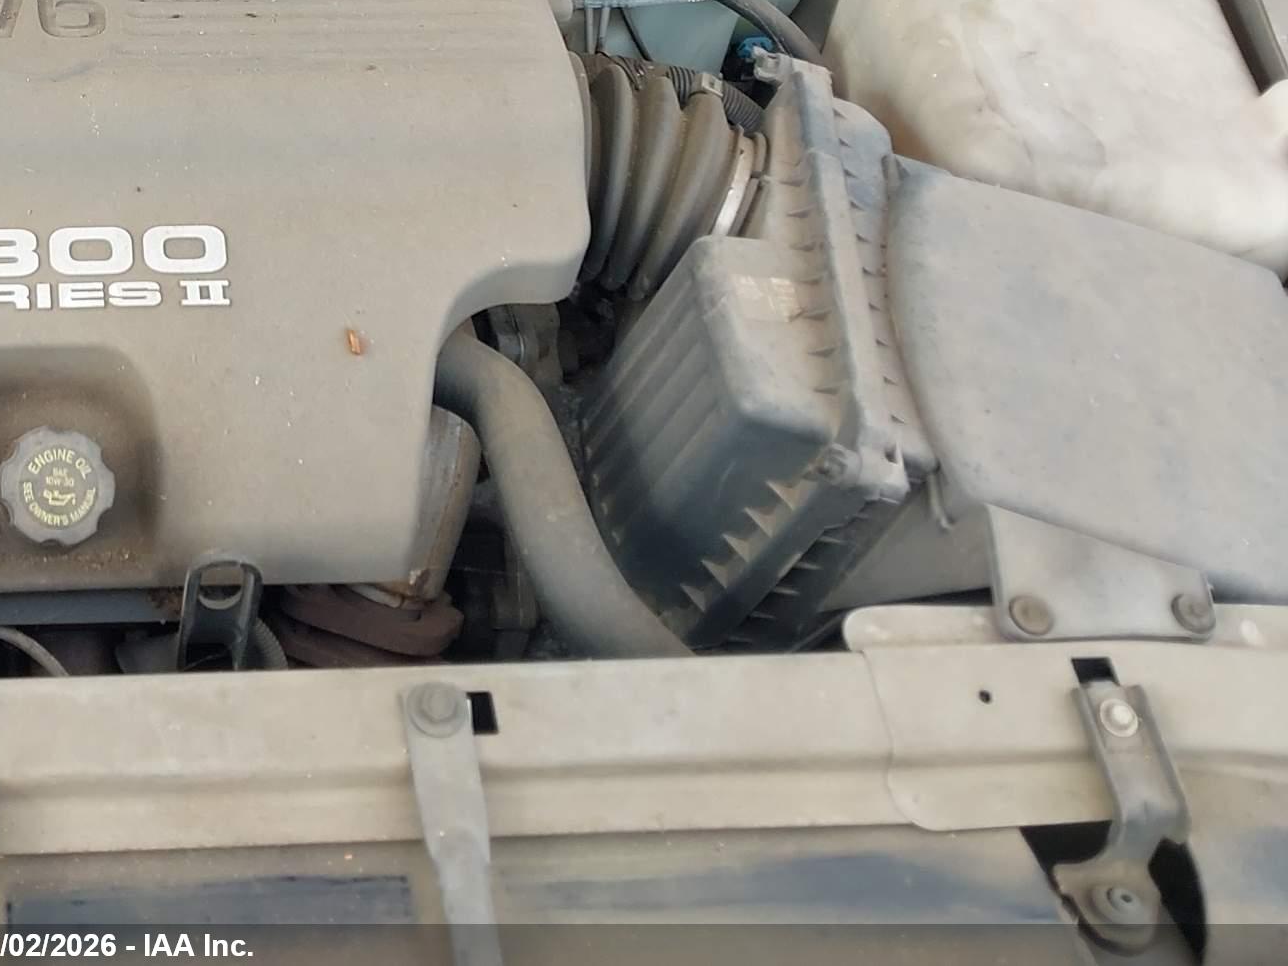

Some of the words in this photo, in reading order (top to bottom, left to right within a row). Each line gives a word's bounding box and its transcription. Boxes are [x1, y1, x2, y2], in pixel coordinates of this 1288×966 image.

[179, 279, 231, 307] II
[28, 448, 76, 475] ENGINE
[75, 458, 93, 480] OIL
[23, 481, 34, 503] SEE
[29, 502, 70, 526] OWNER'S
[69, 487, 96, 522] MANUAL
